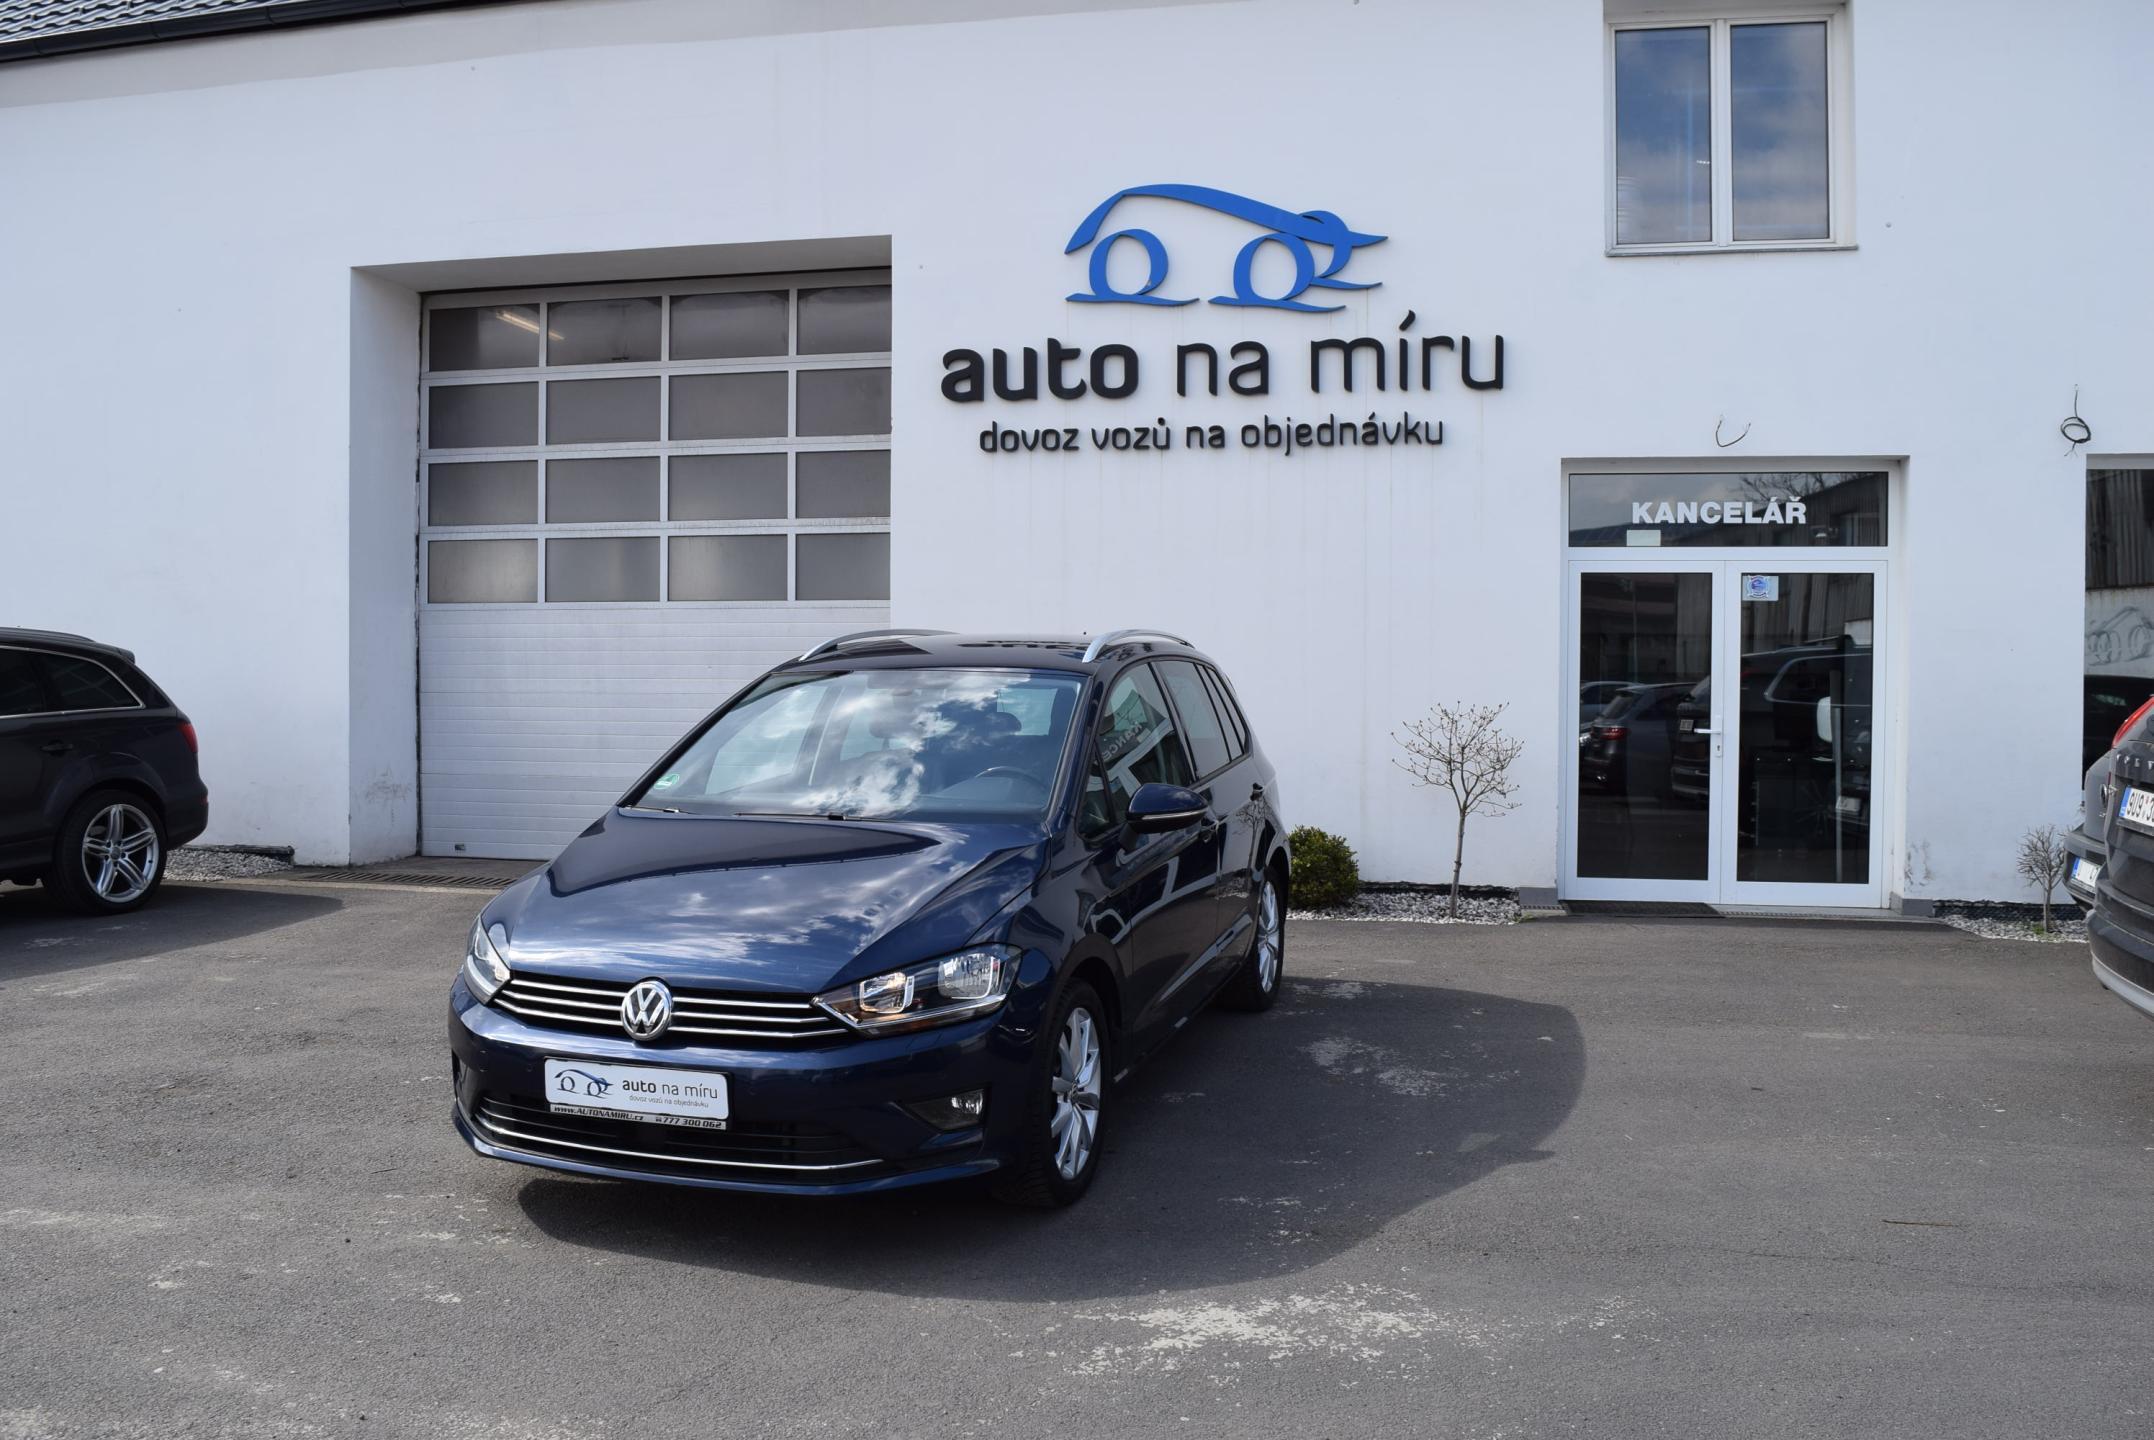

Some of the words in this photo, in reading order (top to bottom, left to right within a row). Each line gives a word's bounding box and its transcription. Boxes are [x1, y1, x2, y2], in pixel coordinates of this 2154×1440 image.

[940, 337, 1139, 404] auto
[1176, 340, 1270, 397] na
[1310, 309, 1504, 393] míru
[979, 420, 1080, 454] dovoz
[1091, 417, 1171, 451] vozů
[1185, 424, 1226, 449] na
[1240, 411, 1443, 457] objednávku
[1632, 496, 1807, 524] KANCELÁŘ
[622, 1079, 657, 1094] auto
[661, 1083, 680, 1096] na
[684, 1083, 719, 1099] míru
[663, 1116, 680, 1125] 777
[682, 1118, 701, 1127] 300
[702, 1120, 722, 1129] 062
